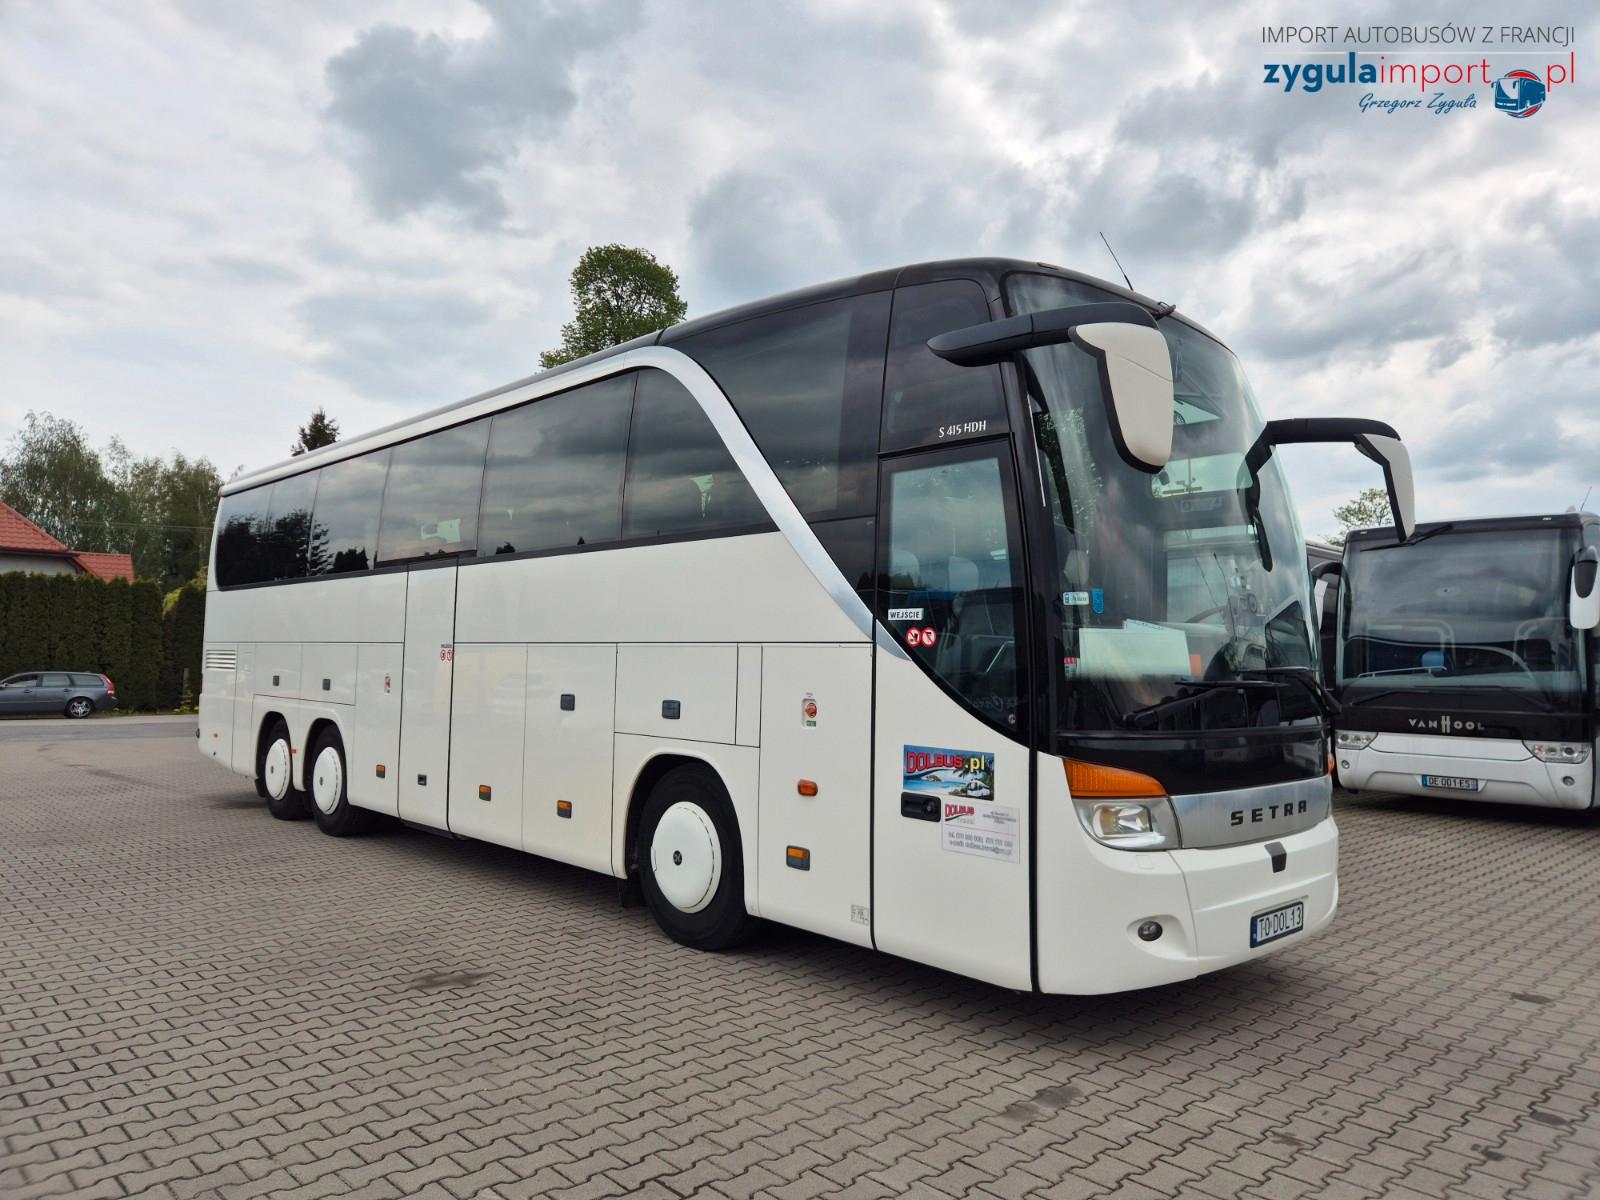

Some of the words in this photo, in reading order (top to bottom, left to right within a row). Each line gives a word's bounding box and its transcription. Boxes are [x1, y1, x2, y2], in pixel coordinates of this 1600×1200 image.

[938, 426, 945, 438] S
[946, 424, 962, 436] 415
[964, 419, 987, 433] HDH
[1231, 800, 1307, 826] SETRA
